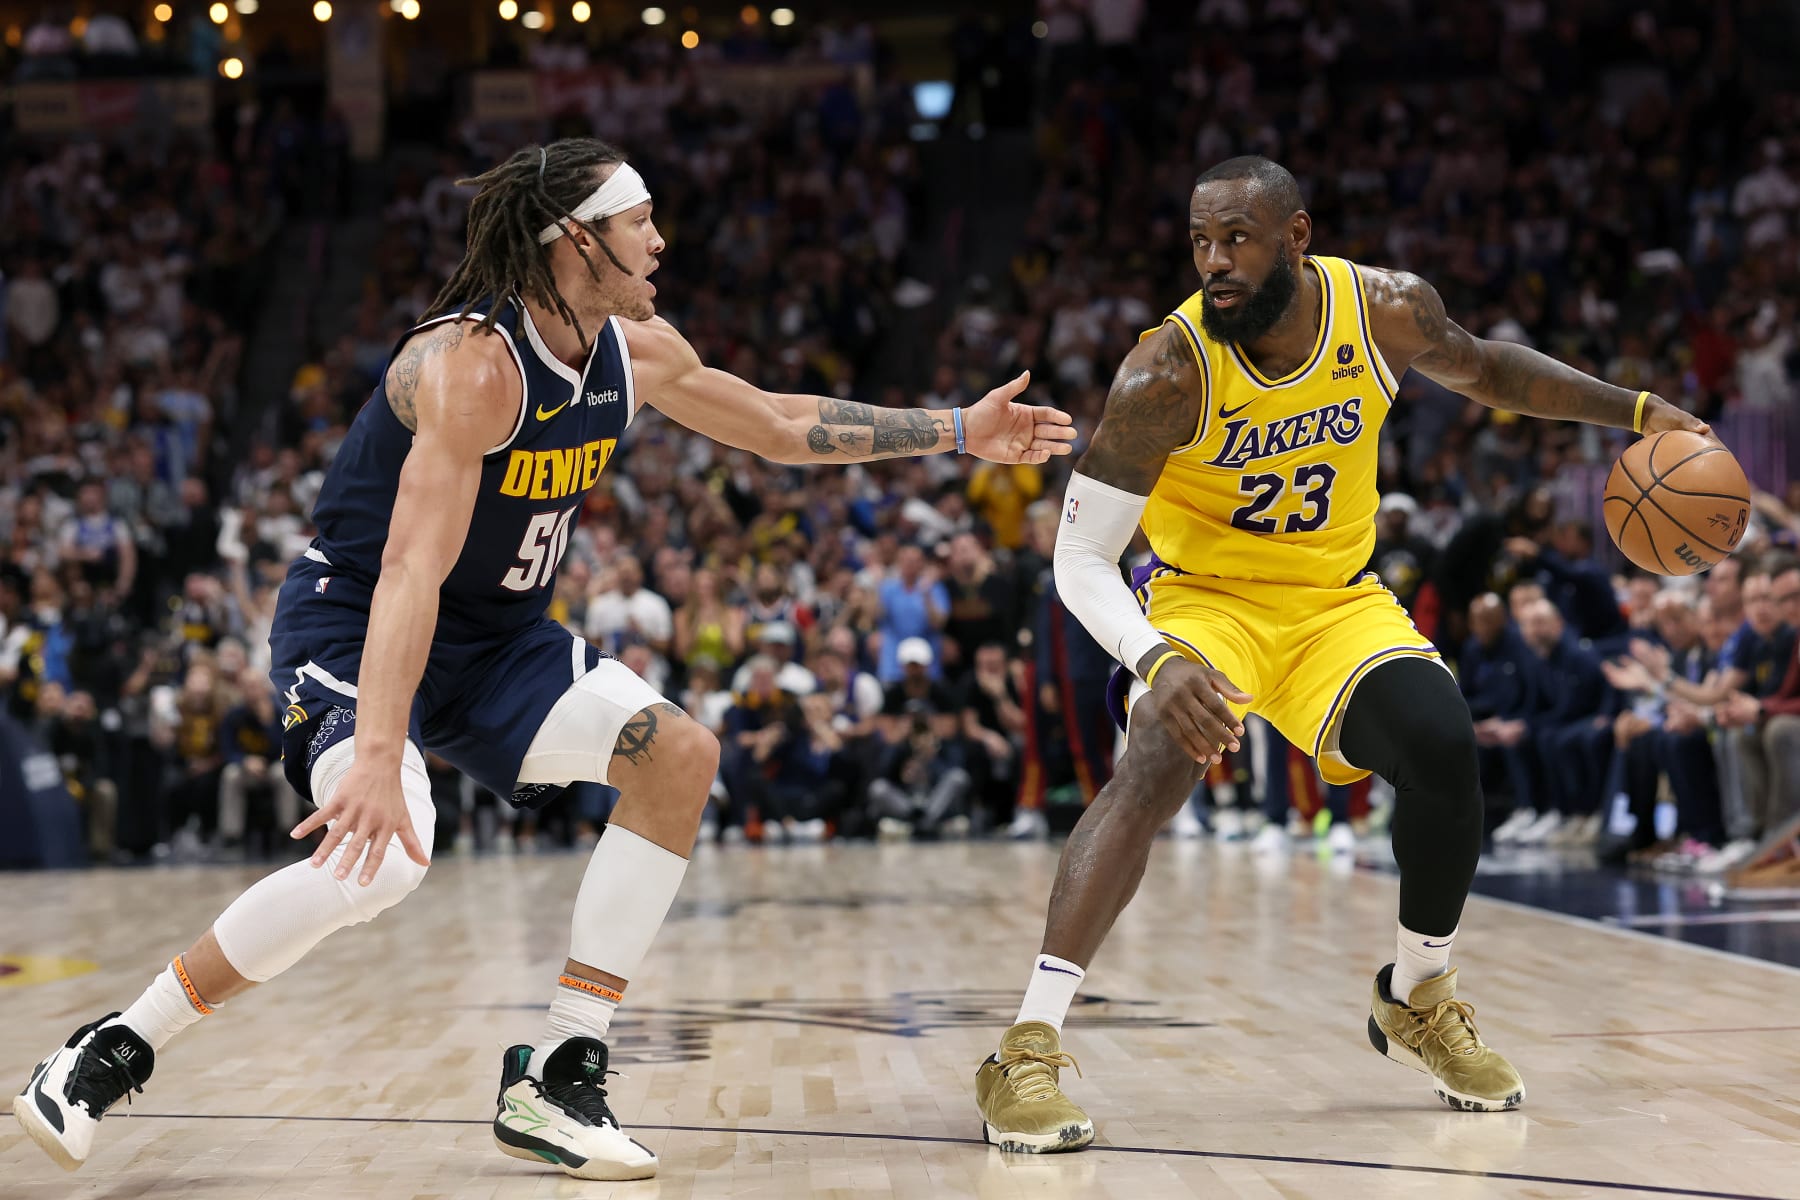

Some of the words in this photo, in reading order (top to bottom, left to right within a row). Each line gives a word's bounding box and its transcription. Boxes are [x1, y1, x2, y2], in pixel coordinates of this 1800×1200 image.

[586, 389, 618, 406] ibotta
[1332, 364, 1364, 380] bibigo
[1202, 396, 1364, 470] LAKERS
[1229, 461, 1338, 534] 23
[500, 504, 577, 592] 50
